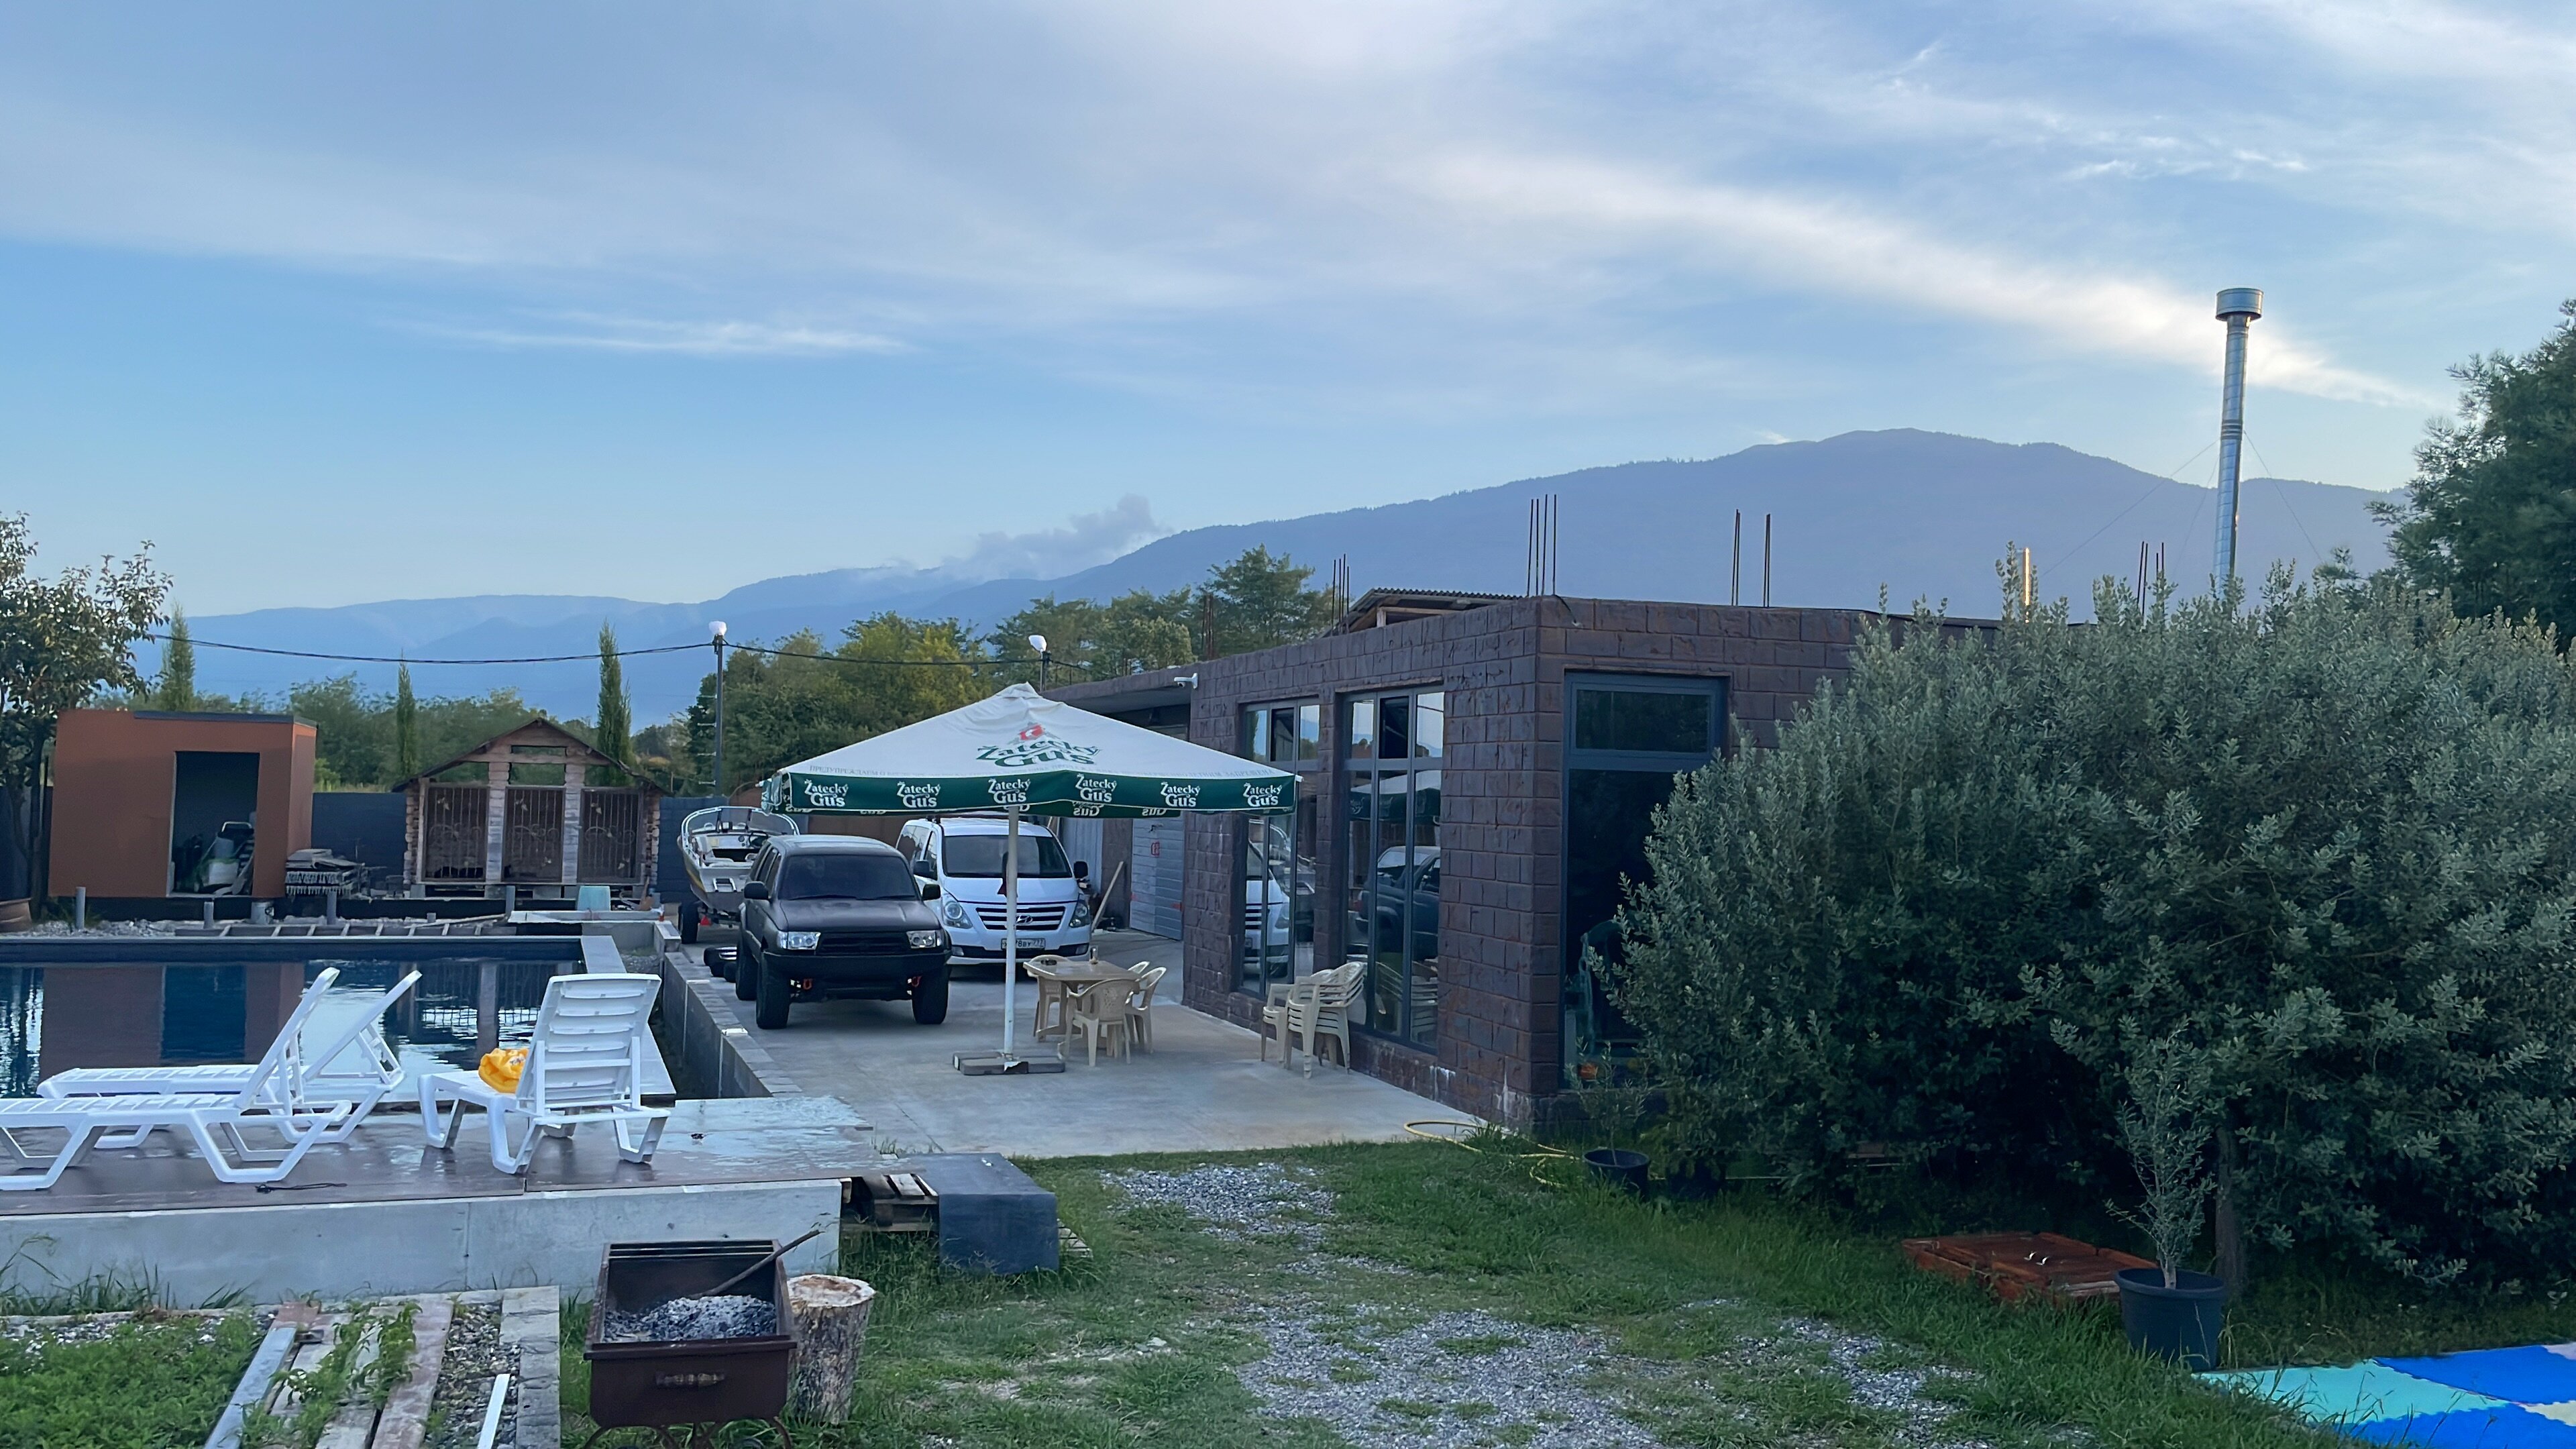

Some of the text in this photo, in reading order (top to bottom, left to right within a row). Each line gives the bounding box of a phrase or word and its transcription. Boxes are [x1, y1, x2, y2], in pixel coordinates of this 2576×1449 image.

[994, 748, 1094, 767] Gus
[804, 779, 848, 796] Žatecký
[897, 781, 941, 797] Žatecký
[988, 778, 1031, 794] Žatecký
[1075, 773, 1117, 792] Žatecký
[1161, 781, 1201, 796] Žatecký
[1243, 782, 1283, 797] Žatecký
[810, 793, 845, 807] Gus
[902, 794, 937, 808] Gus
[994, 791, 1026, 804] Gus
[1080, 788, 1112, 803] Gus
[1165, 794, 1197, 807] Gus
[1247, 794, 1279, 807] Gus
